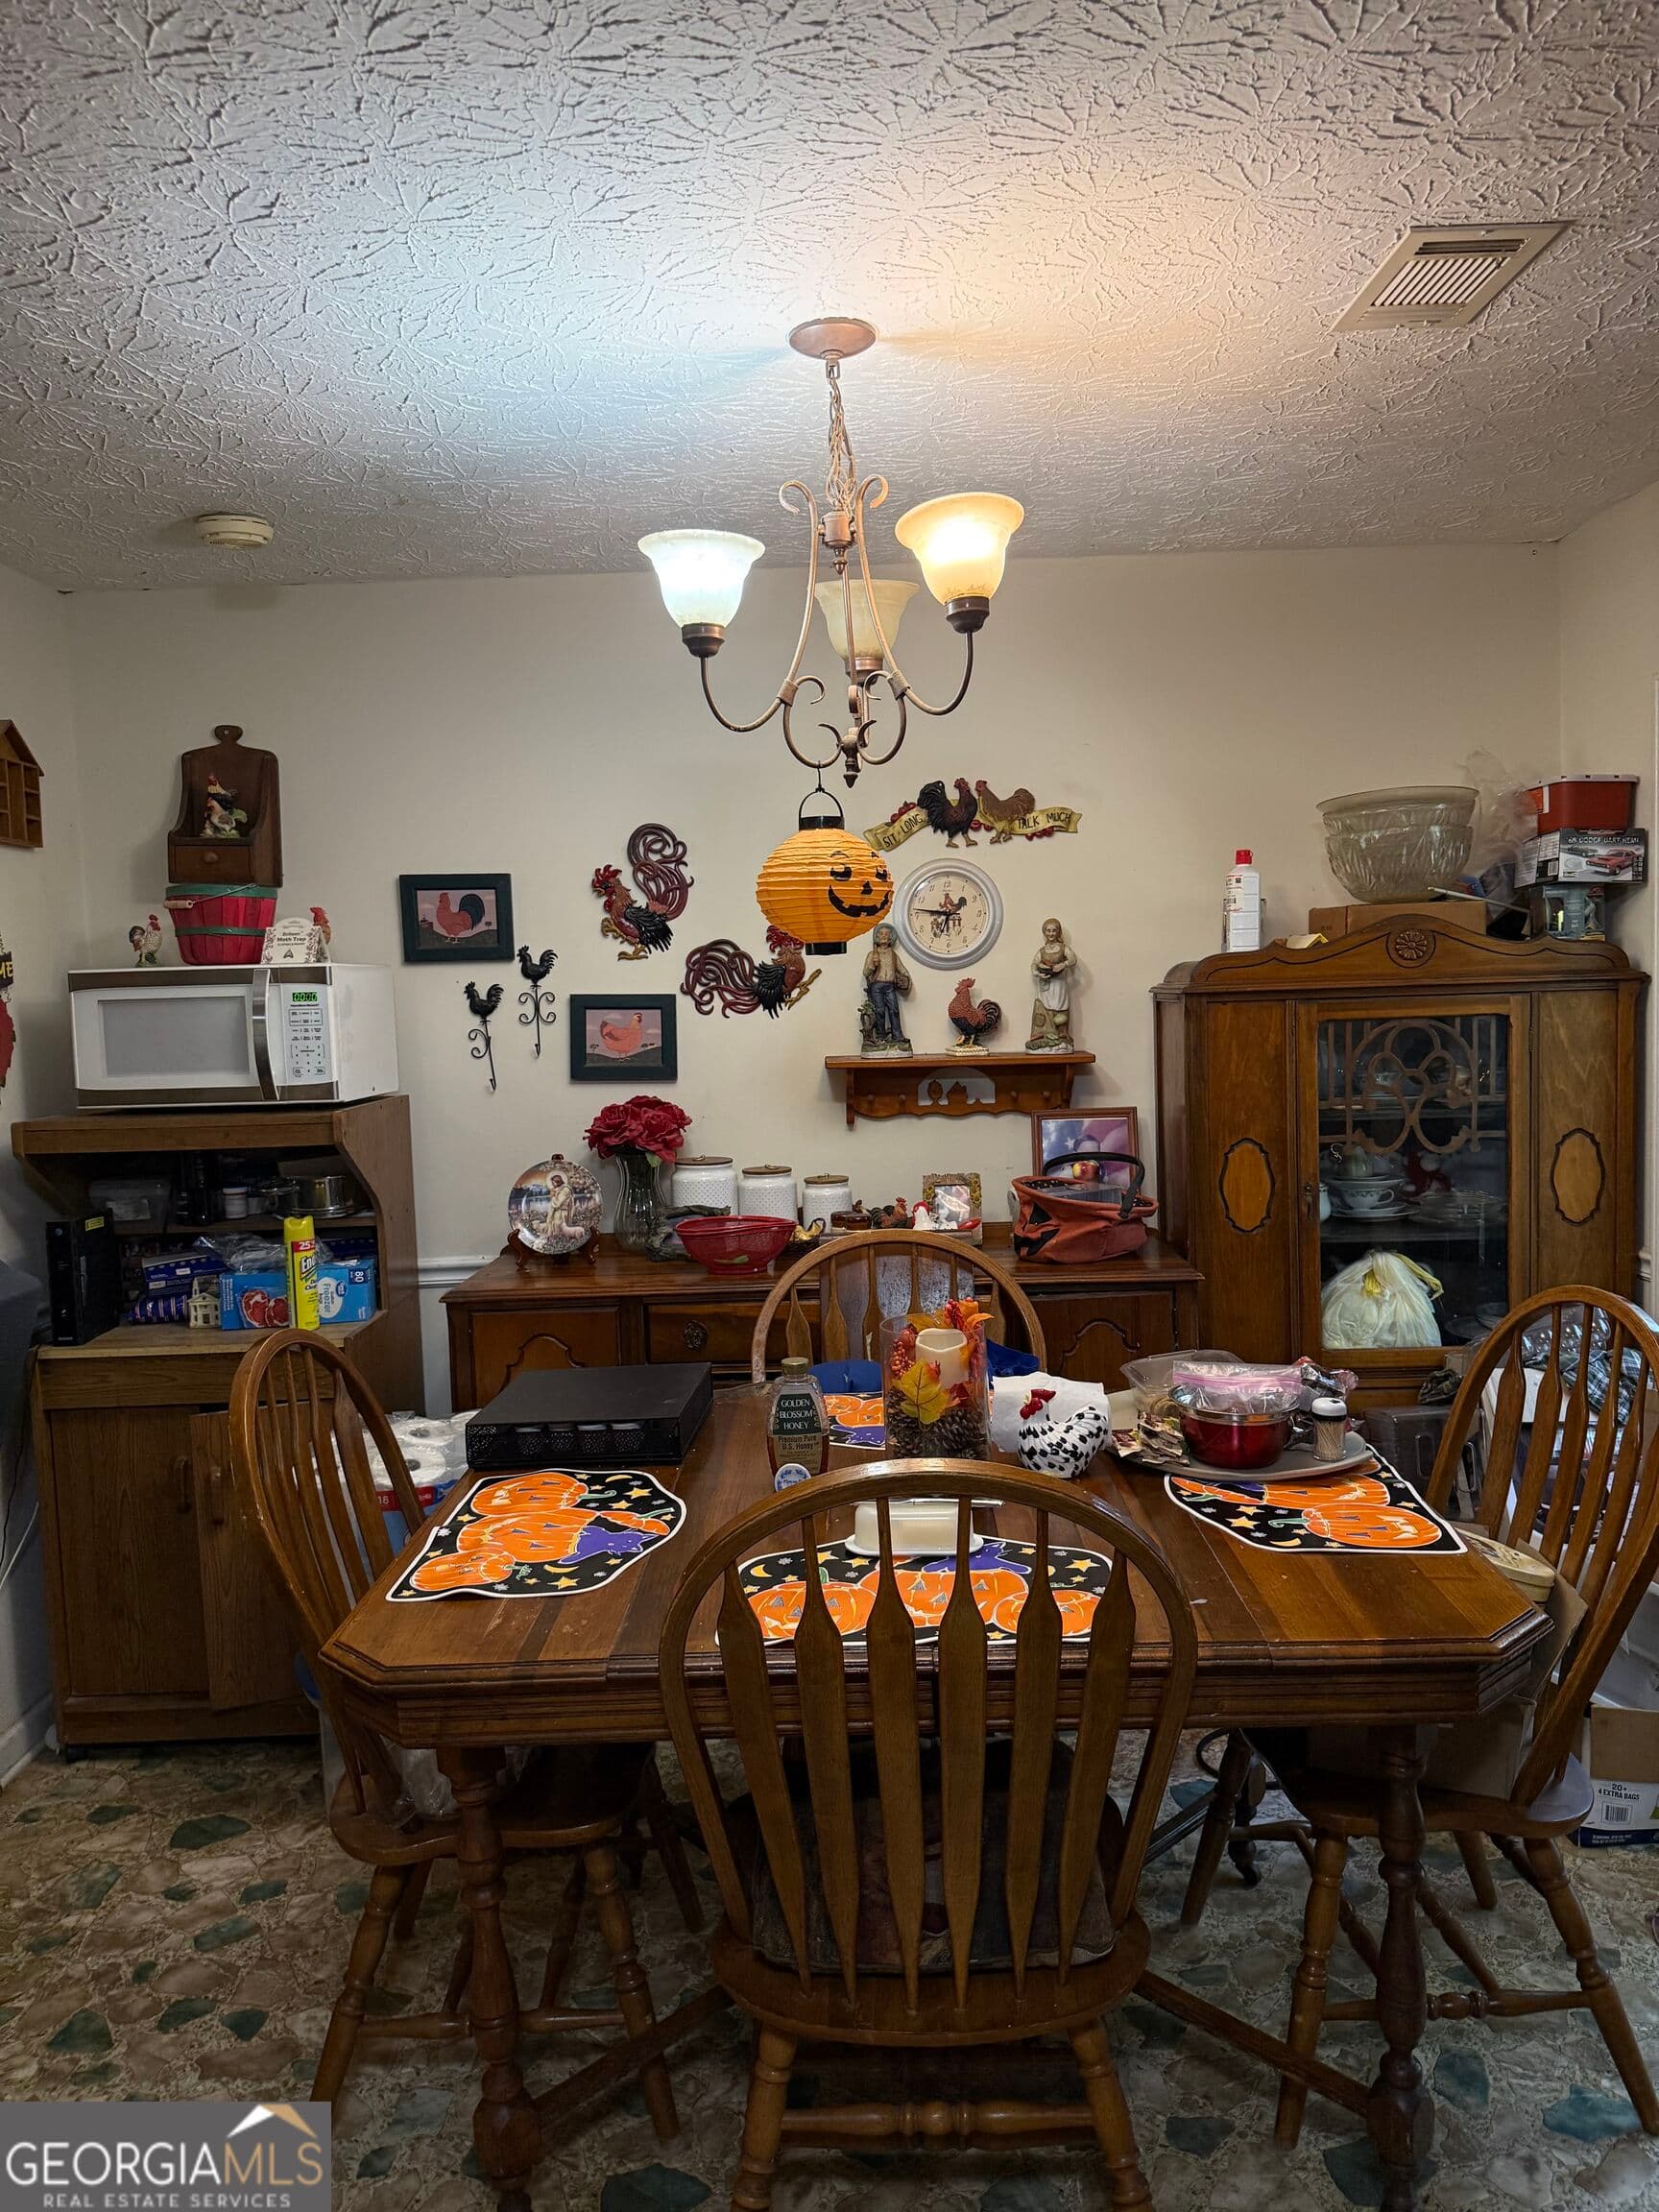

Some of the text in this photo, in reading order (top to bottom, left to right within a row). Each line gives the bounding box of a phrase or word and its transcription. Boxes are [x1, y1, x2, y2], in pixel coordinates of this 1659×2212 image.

[1017, 811, 1072, 830] TALK MUCH
[882, 814, 923, 848] SIT LONG
[355, 1271, 364, 1283] 80
[781, 1399, 810, 1407] GOLDEN
[779, 1411, 813, 1419] BLOSSOM
[783, 1422, 808, 1430] HONEY
[378, 1496, 389, 1504] 18
[1603, 1789, 1623, 1799] EXTRA
